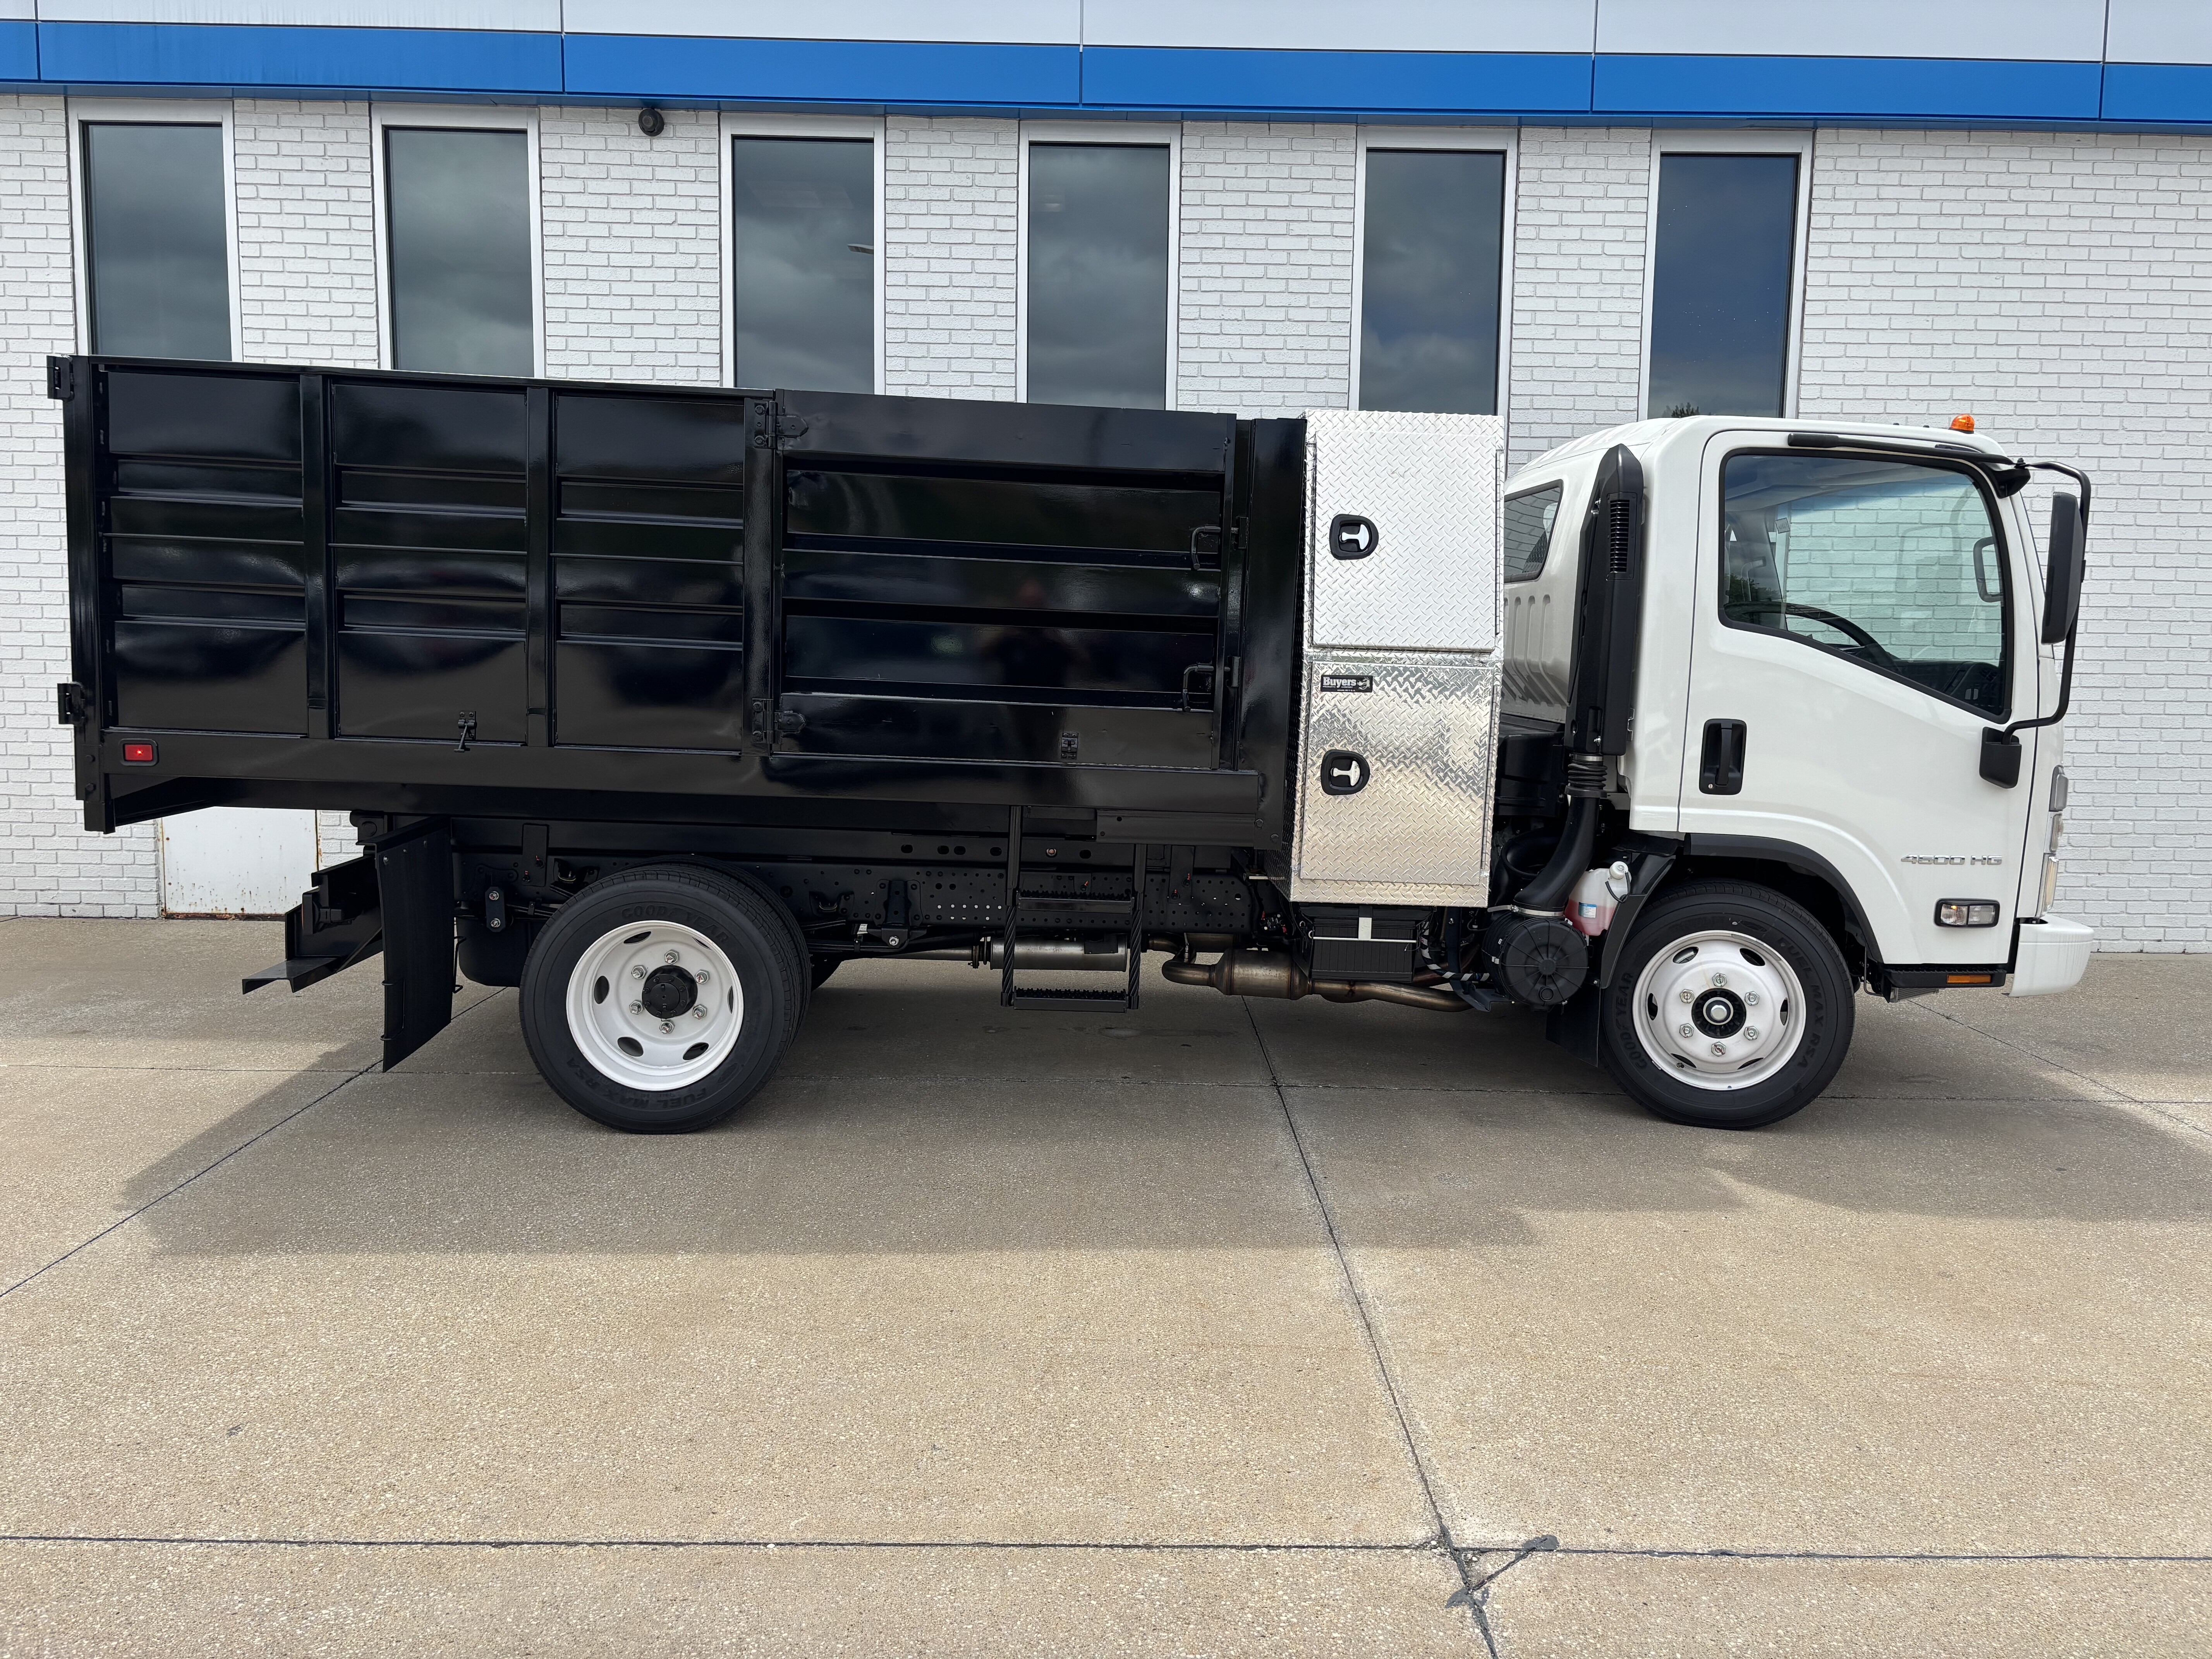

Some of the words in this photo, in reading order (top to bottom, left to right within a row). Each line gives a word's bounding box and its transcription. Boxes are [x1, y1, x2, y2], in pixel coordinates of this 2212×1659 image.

[1323, 677, 1357, 688] Buyers
[1901, 854, 1965, 865] 4500
[1970, 855, 2003, 866] HG
[1777, 936, 1812, 979] FUEL
[1809, 984, 1824, 1027] MAX
[1797, 1032, 1821, 1068] RSA
[566, 1057, 600, 1090] RSA
[603, 1089, 650, 1109] MAX
[656, 1087, 707, 1109] FUEL
